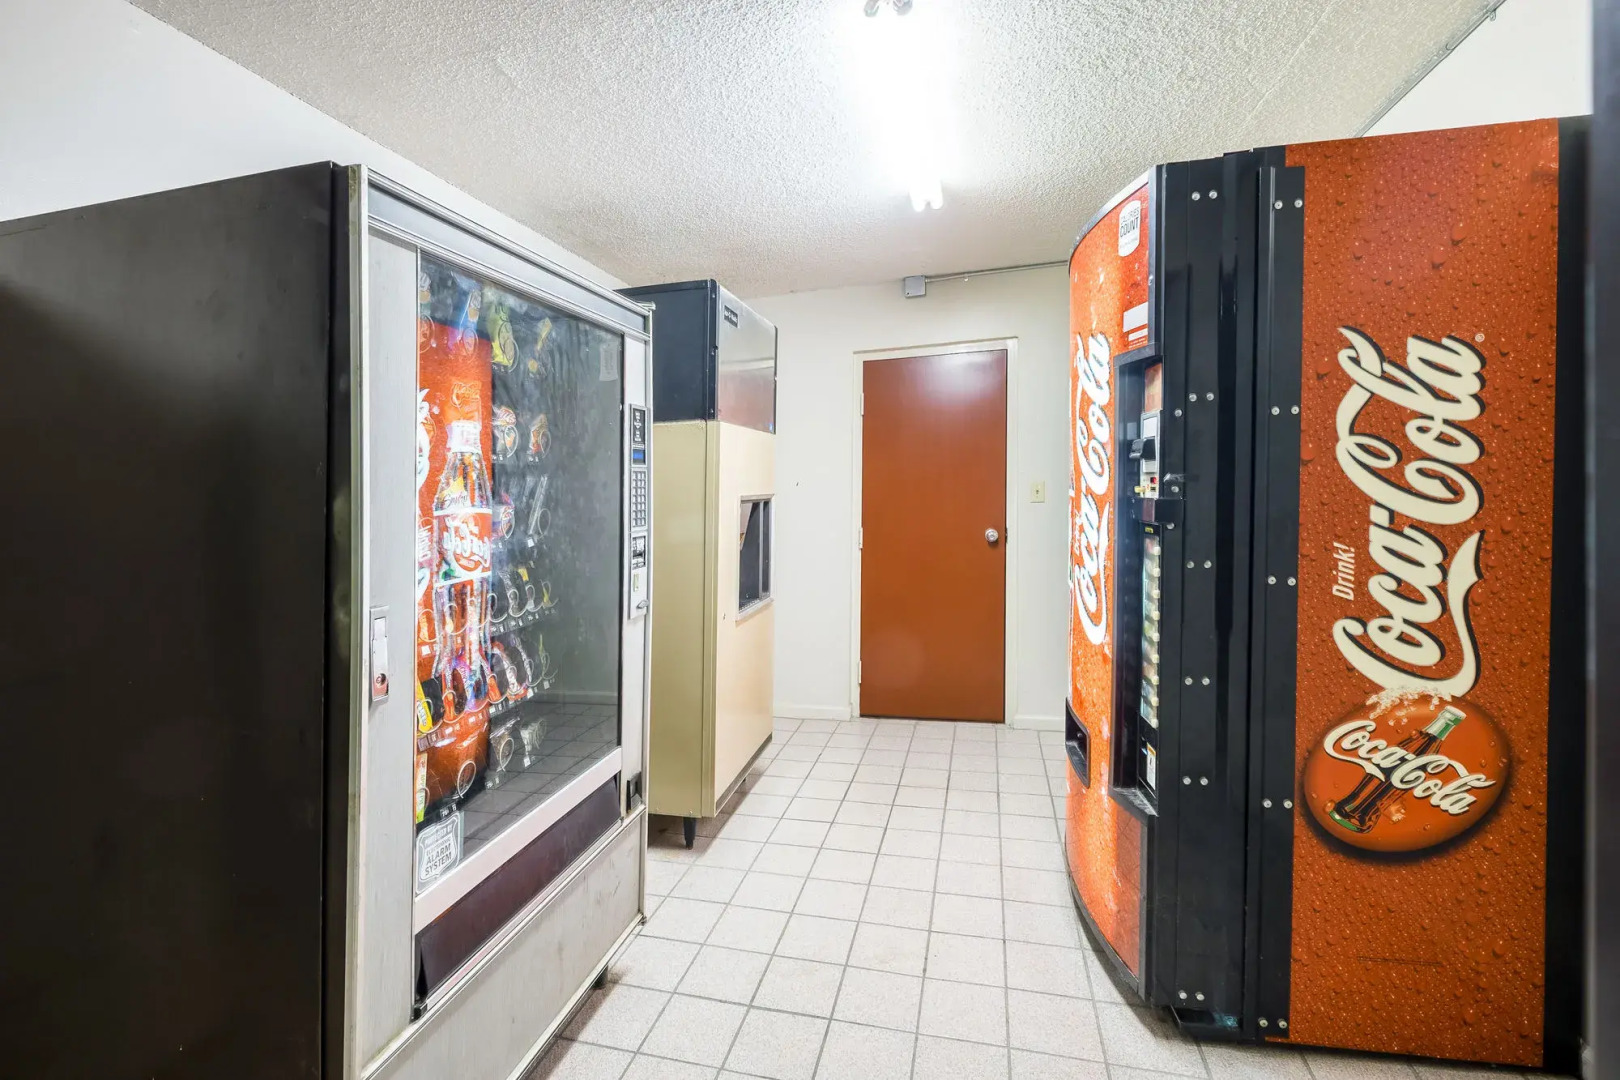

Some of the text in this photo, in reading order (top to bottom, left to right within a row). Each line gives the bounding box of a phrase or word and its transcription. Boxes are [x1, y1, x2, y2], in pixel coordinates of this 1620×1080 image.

[1120, 216, 1139, 237] COUNT
[1074, 331, 1110, 646] Coca-Cola
[1333, 326, 1486, 698] Coca-Cola
[1332, 541, 1354, 601] Drink!
[1323, 719, 1496, 815] Coca-Cola
[425, 851, 452, 876] SYSTEM
[426, 842, 451, 866] ALARM
